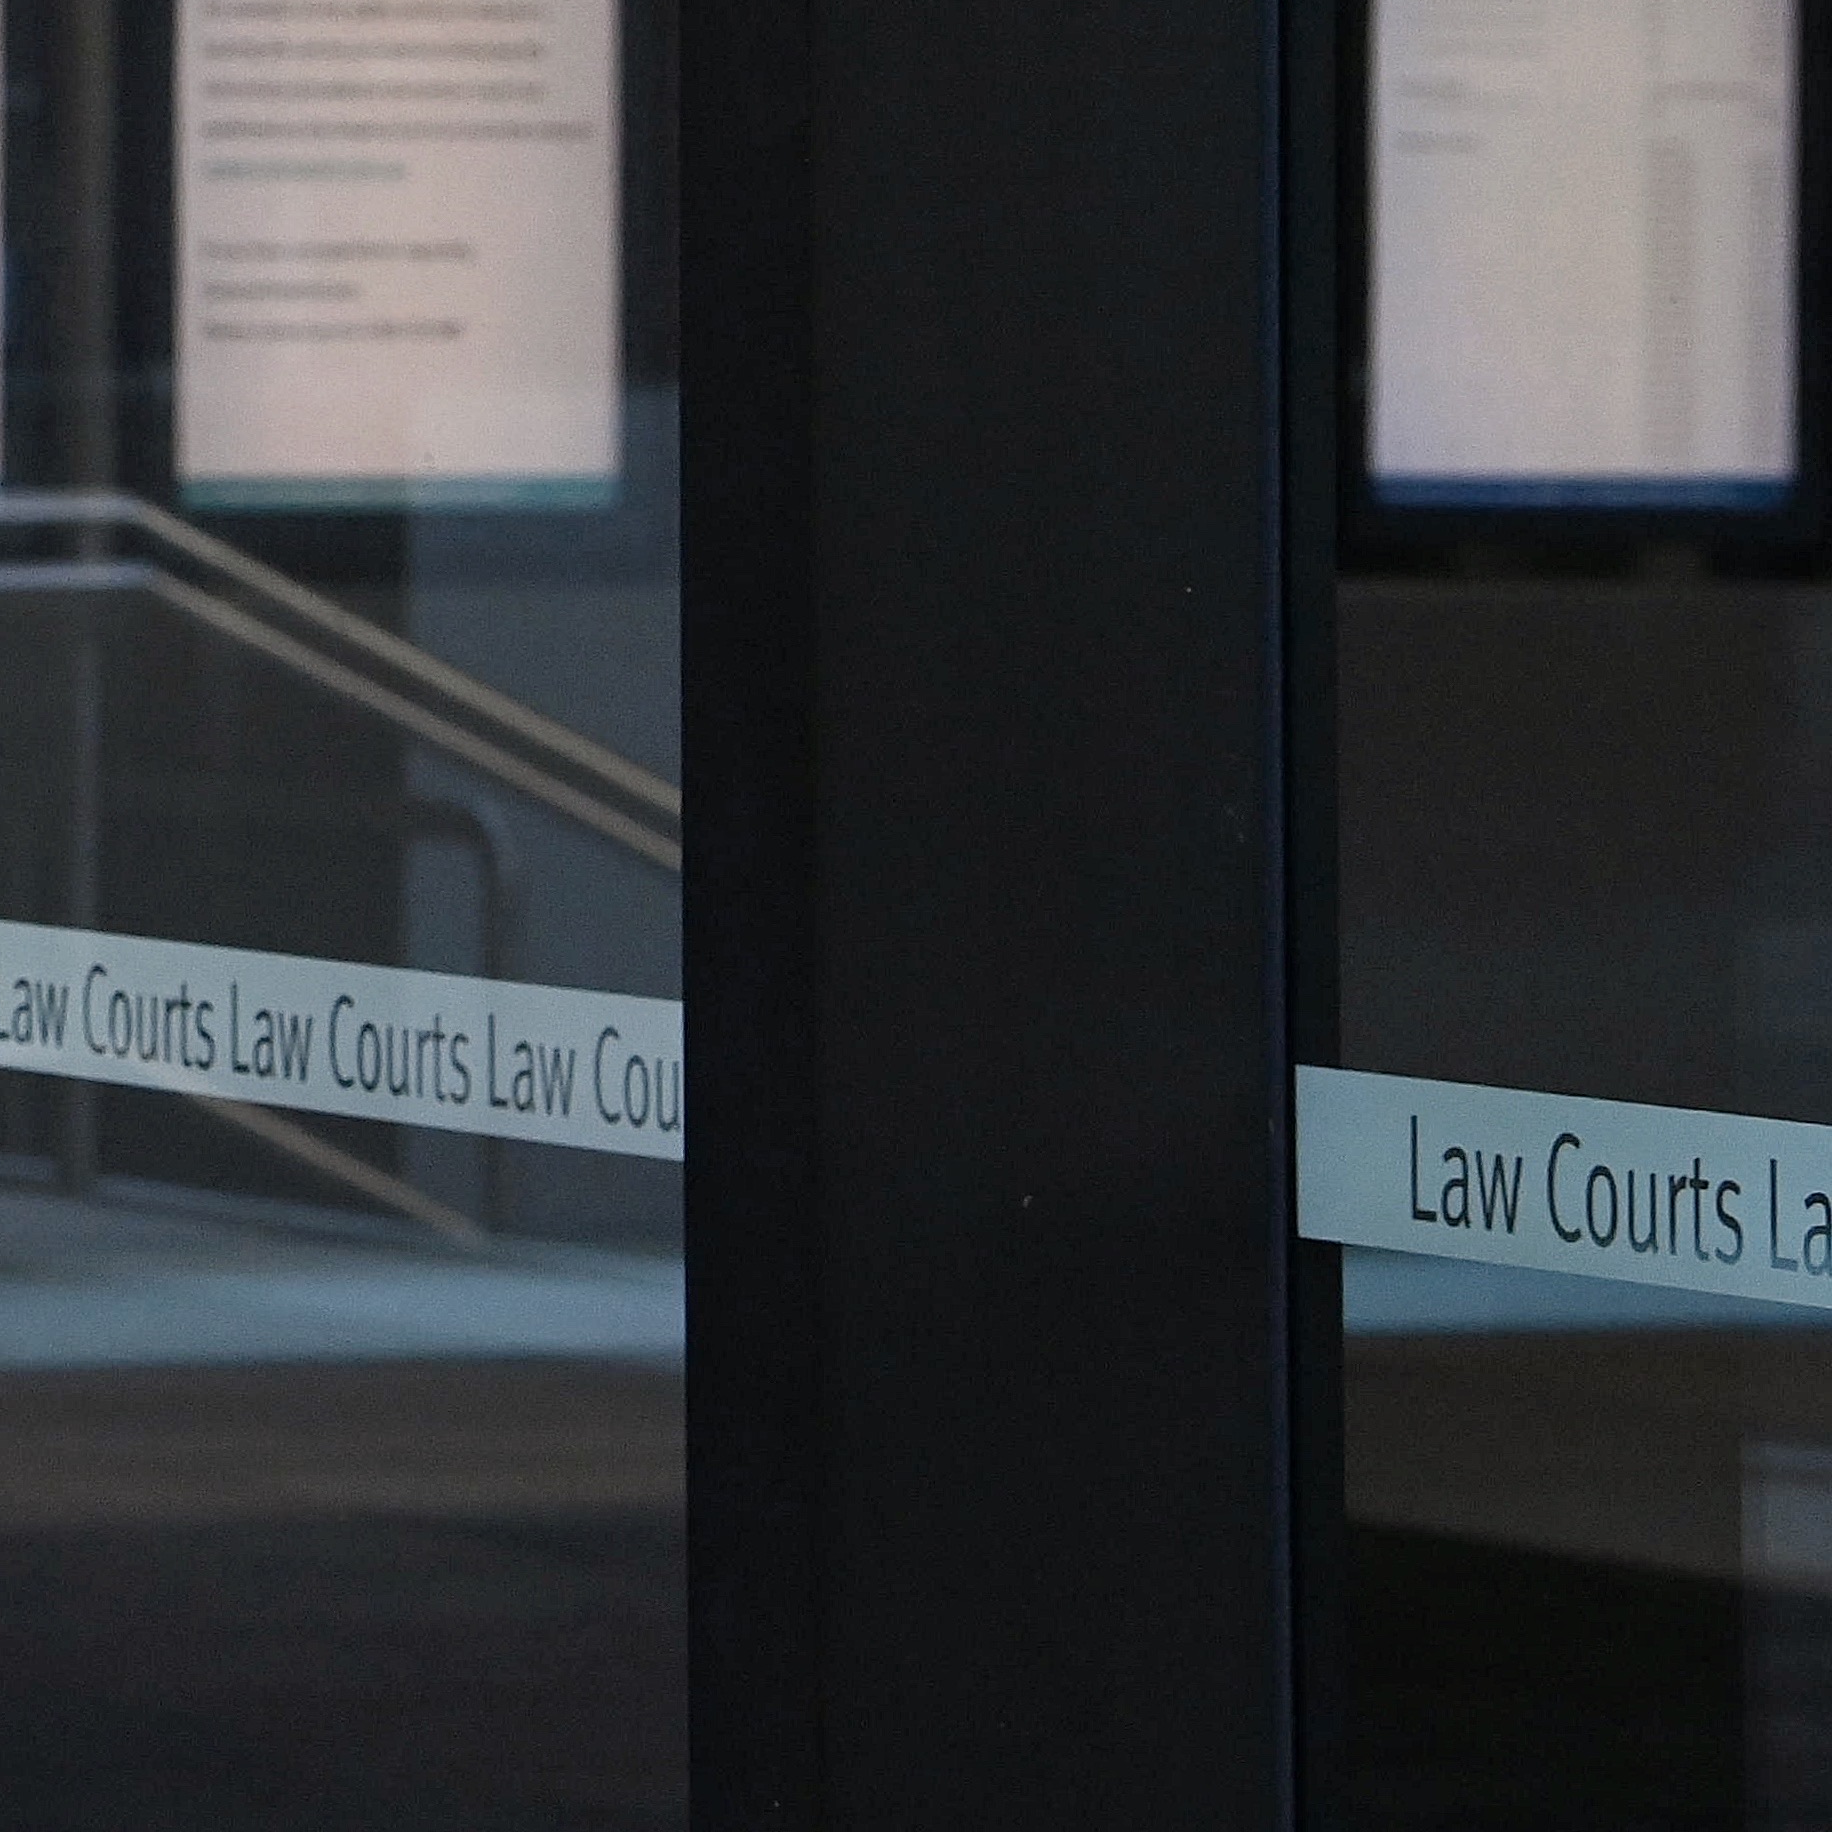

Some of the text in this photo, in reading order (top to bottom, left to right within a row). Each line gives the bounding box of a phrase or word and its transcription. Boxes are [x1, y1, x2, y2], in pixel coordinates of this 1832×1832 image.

[84, 965, 216, 1071] Courts
[231, 982, 313, 1082] Law
[329, 994, 472, 1105] Courts
[489, 1013, 576, 1116] Law
[1410, 1114, 1524, 1235] Law
[1546, 1132, 1746, 1266] Courts
